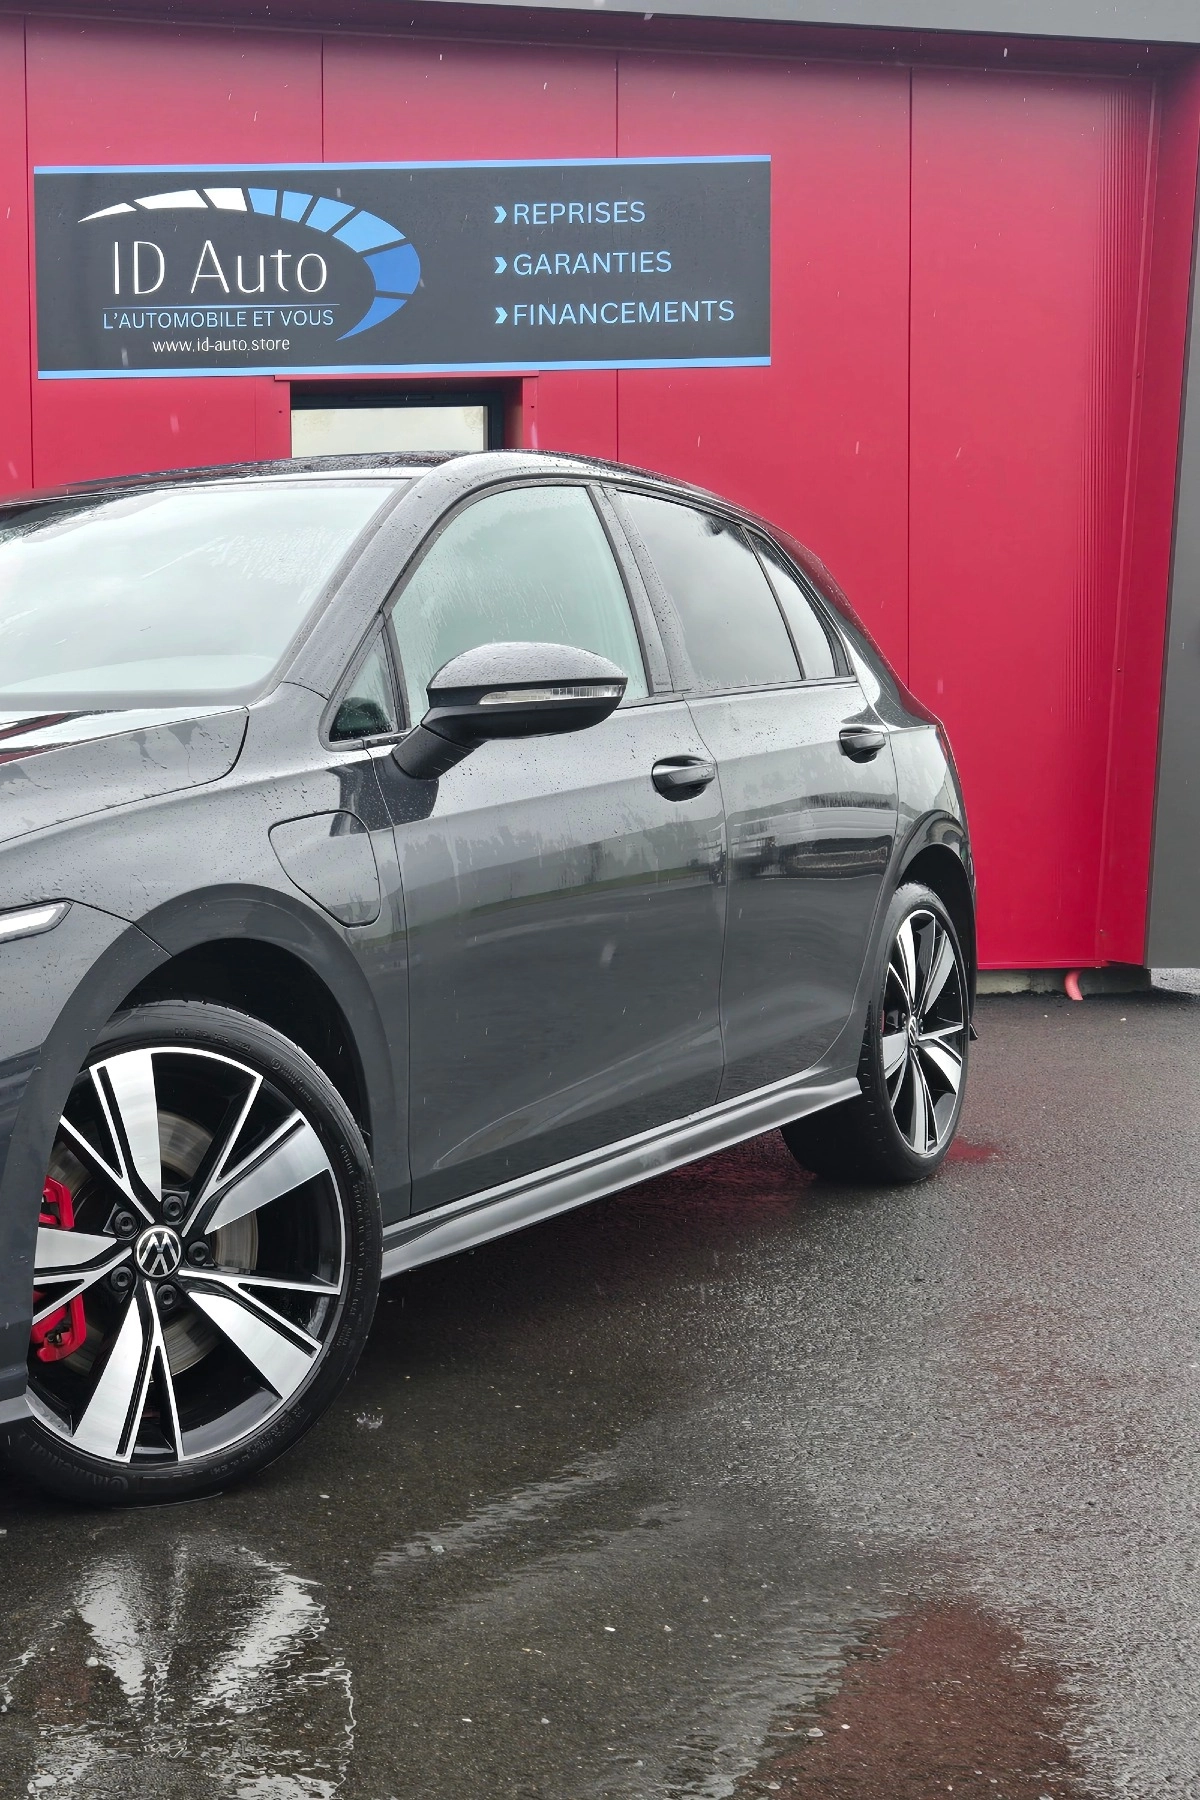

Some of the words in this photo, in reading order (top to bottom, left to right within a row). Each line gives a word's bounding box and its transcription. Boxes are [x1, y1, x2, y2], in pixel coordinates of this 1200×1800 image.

[513, 201, 646, 225] REPRISES
[113, 241, 166, 295] ID
[190, 239, 328, 294] Auto
[513, 251, 673, 276] GARANTIES
[103, 310, 248, 330] L'AUTOMOBILE
[253, 311, 275, 328] ET
[280, 309, 335, 327] VOUS
[513, 300, 735, 326] FINANCEMENTS
[152, 336, 291, 353] www.id-auto.store
